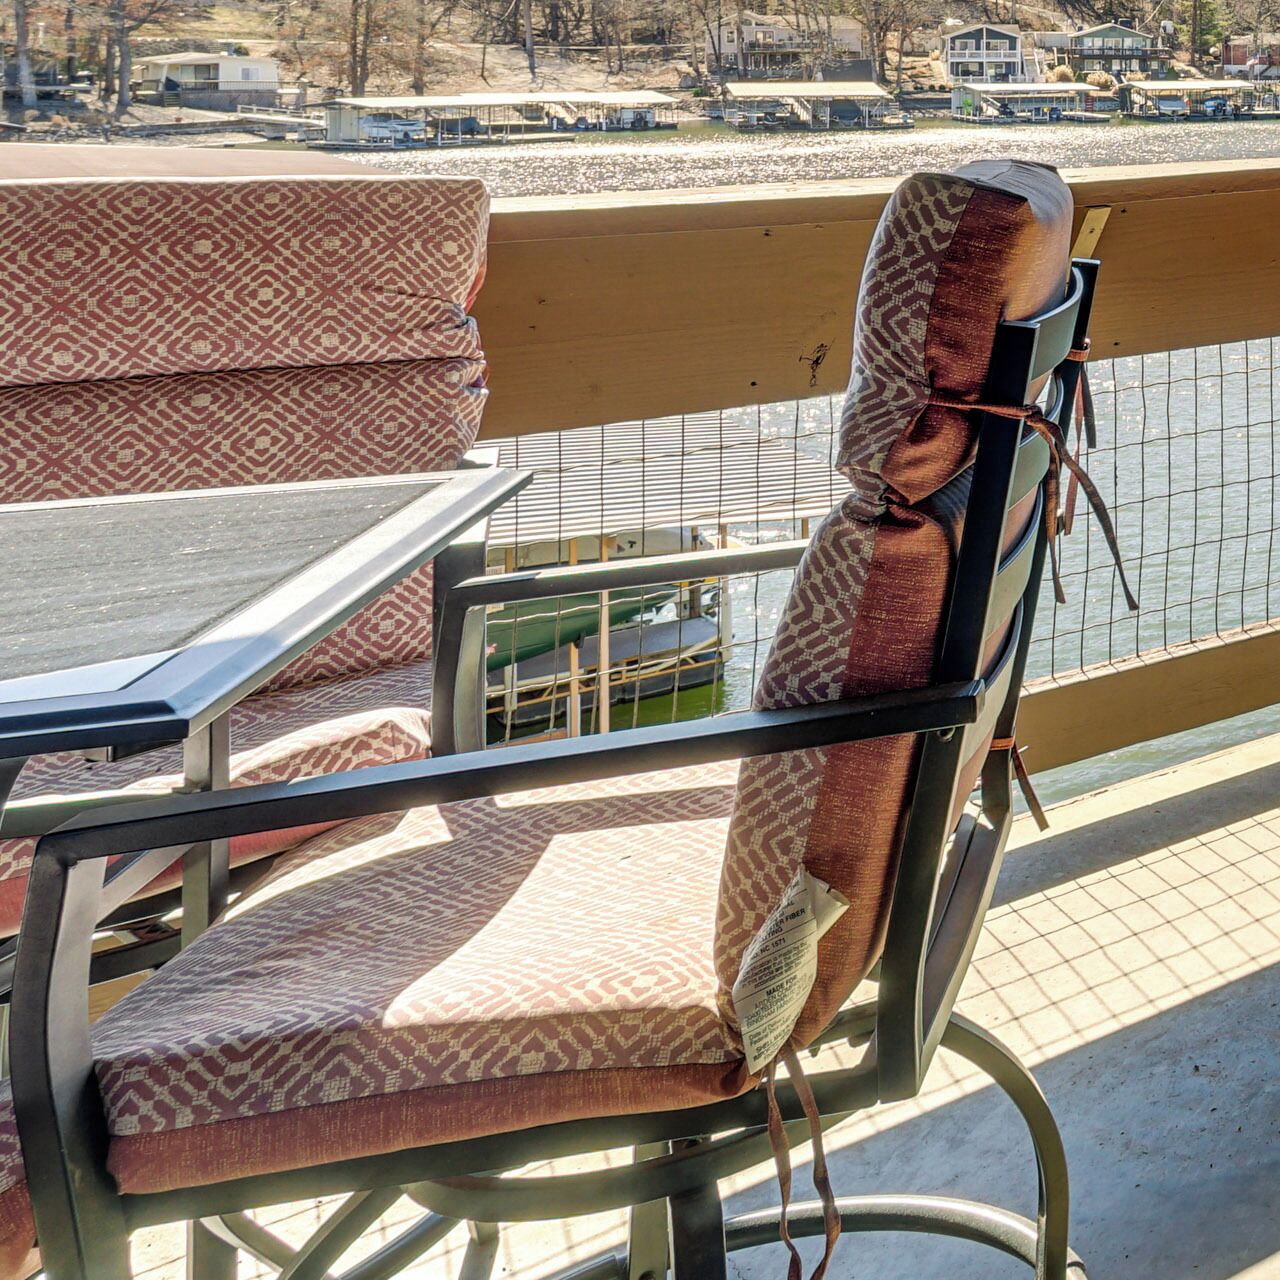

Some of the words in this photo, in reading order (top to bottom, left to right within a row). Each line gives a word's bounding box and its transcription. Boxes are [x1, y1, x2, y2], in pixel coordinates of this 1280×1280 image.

[785, 907, 806, 922] FIBER
[760, 944, 770, 953] NC
[772, 937, 786, 948] 1571
[766, 983, 784, 995] MADE
